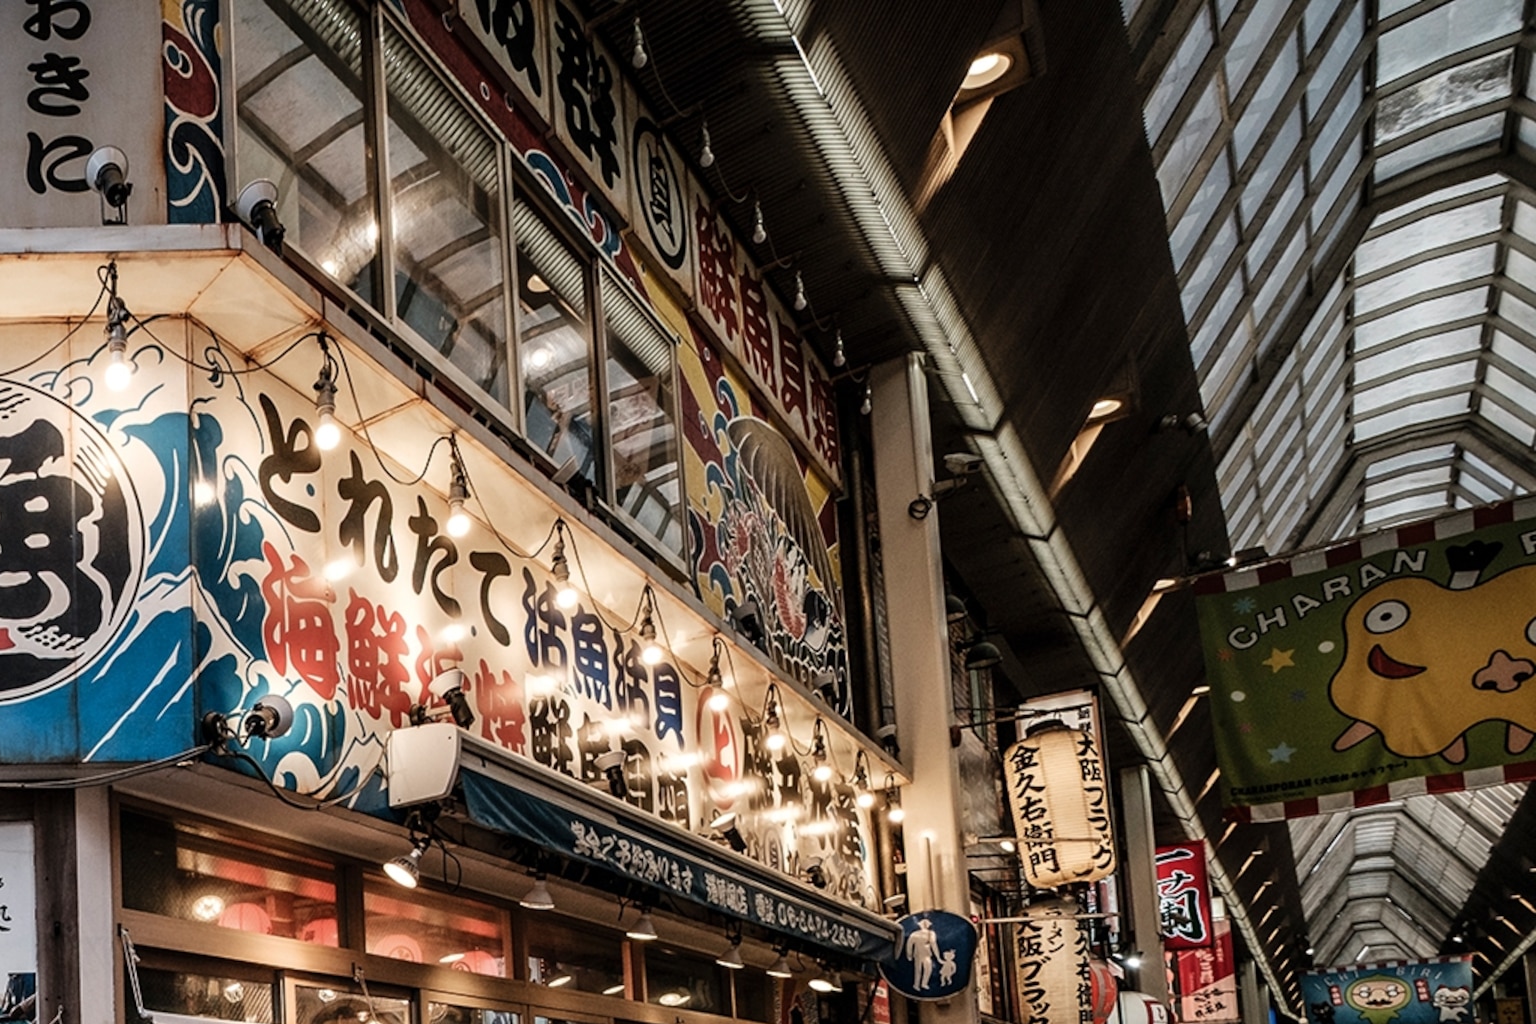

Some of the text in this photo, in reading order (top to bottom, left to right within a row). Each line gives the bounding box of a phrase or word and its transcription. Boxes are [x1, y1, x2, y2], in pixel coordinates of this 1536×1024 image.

[259, 393, 512, 647] とれたて
[1227, 549, 1428, 651] CHARAN
[1010, 745, 1060, 878] 金久右衛門
[1395, 967, 1443, 981] BIRI
